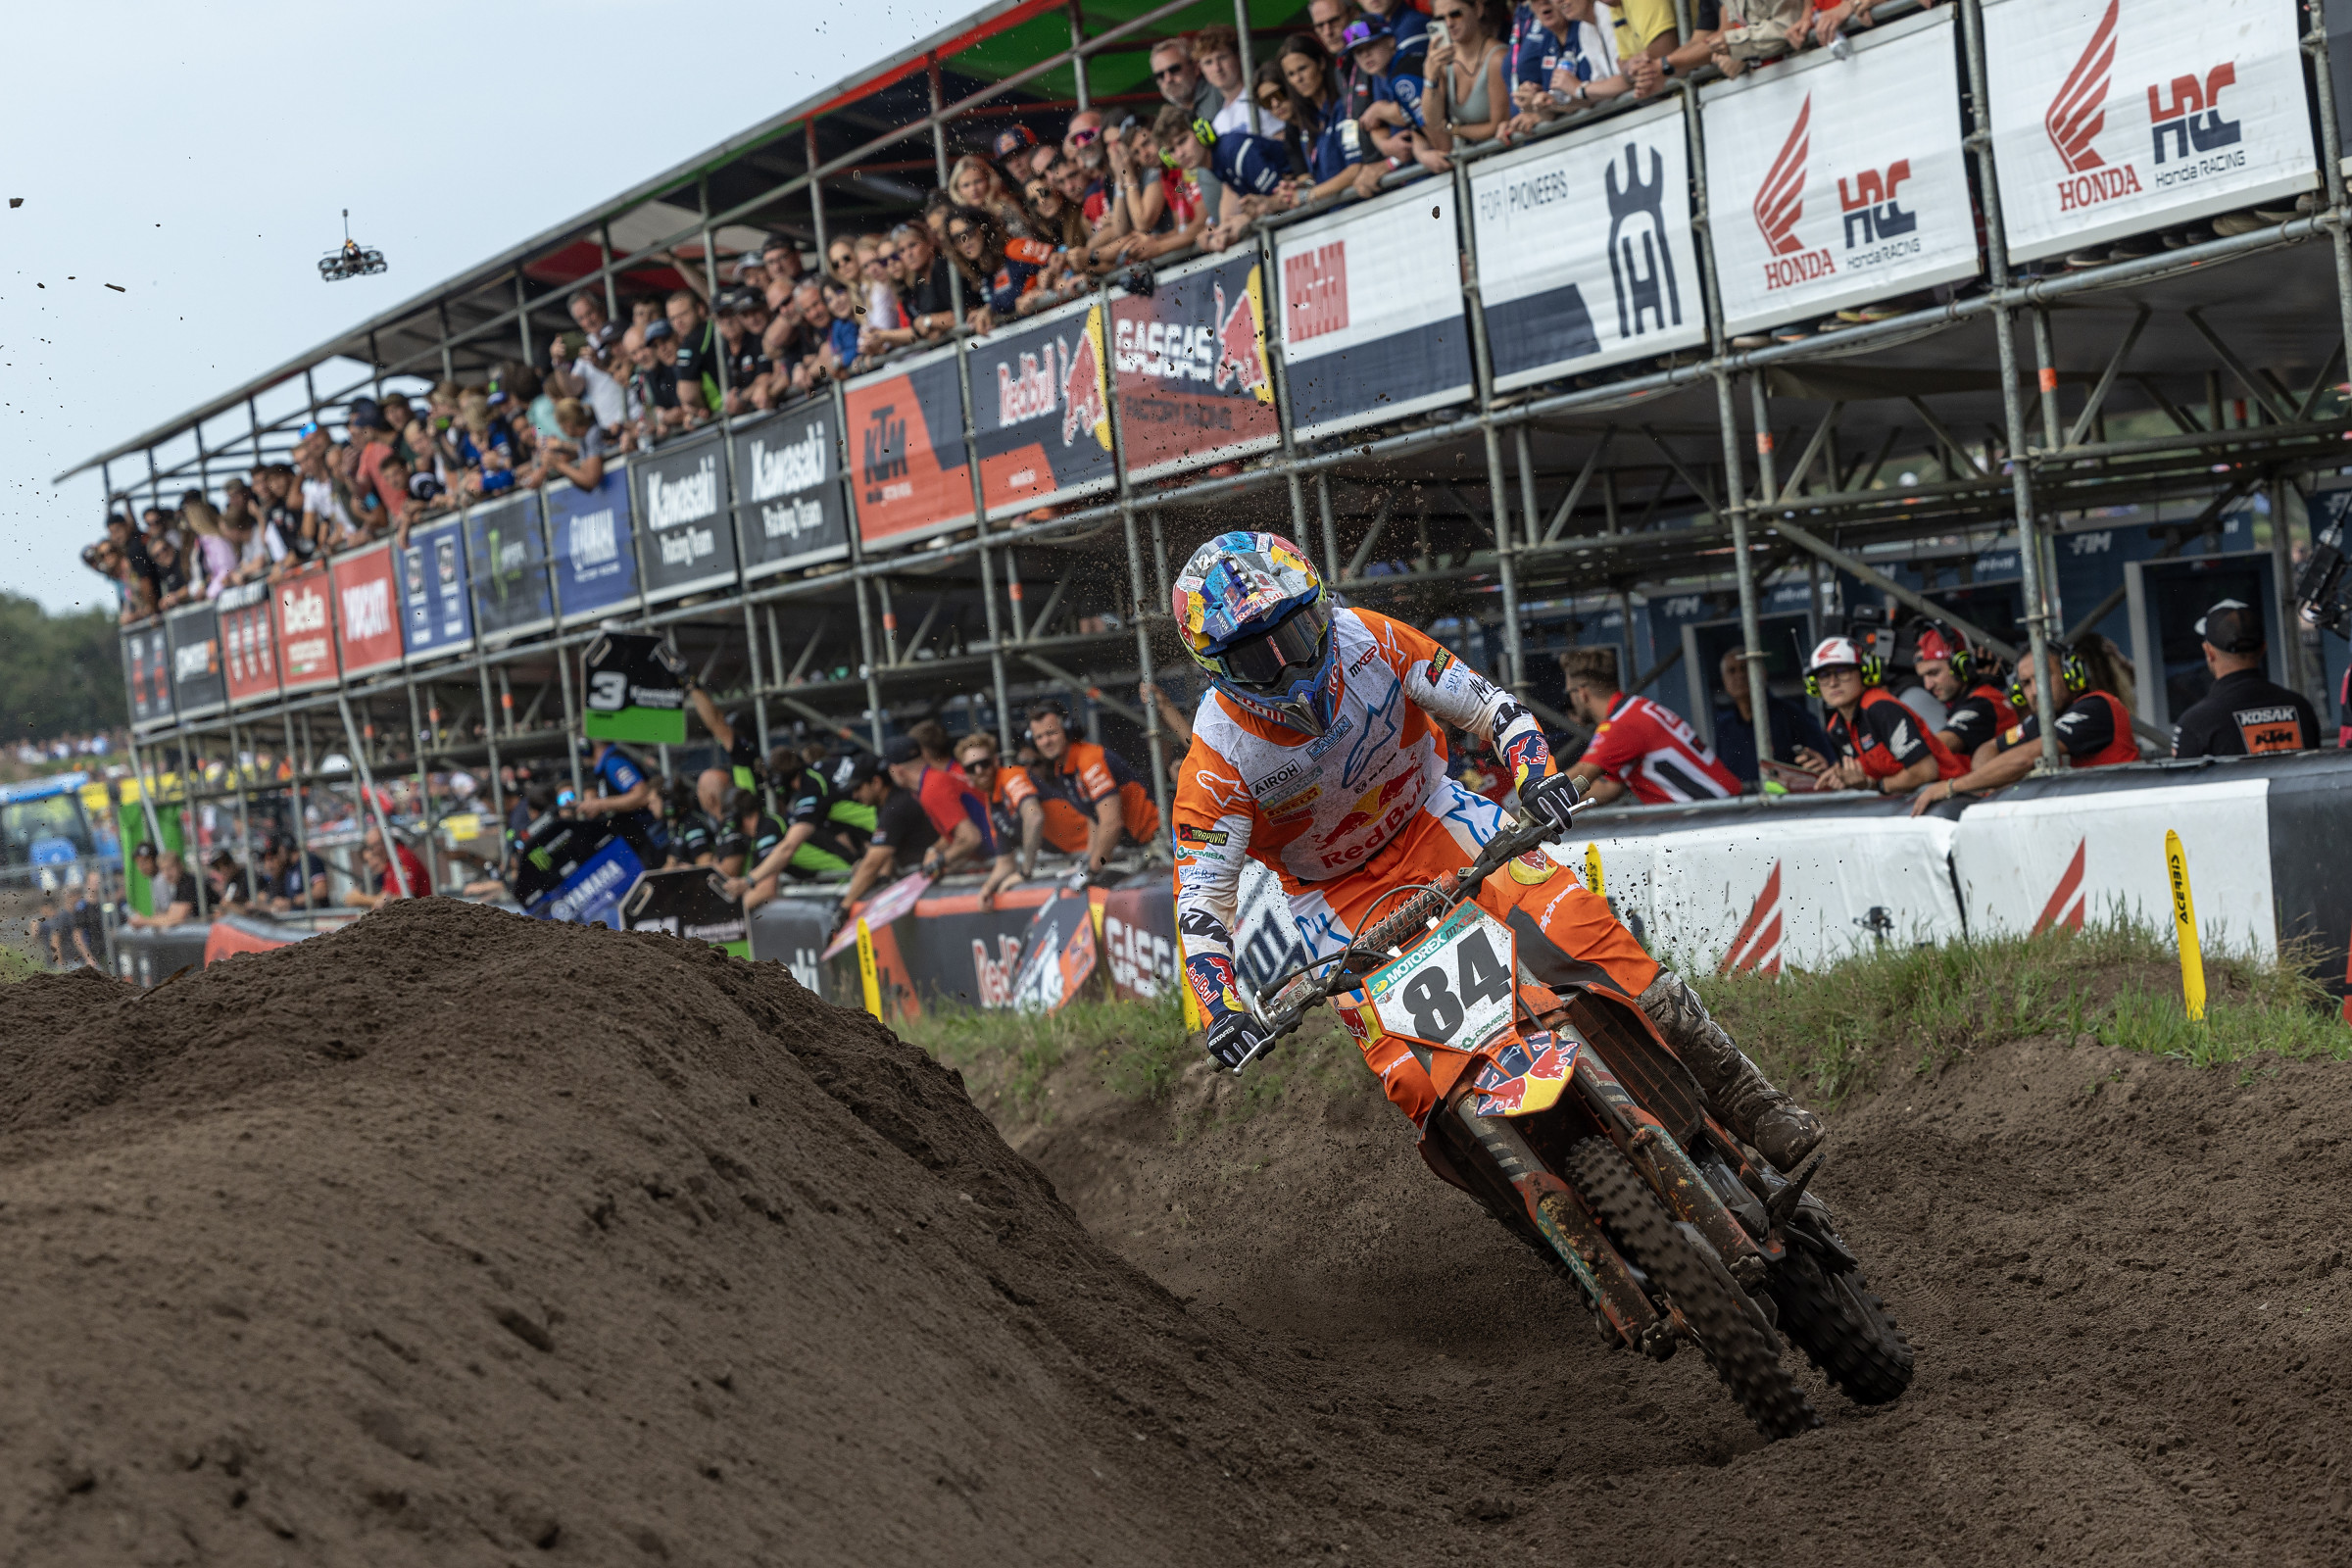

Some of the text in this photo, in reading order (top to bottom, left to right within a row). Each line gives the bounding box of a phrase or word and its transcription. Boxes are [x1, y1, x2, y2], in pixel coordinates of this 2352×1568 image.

[2058, 164, 2143, 212] HONDA
[2155, 149, 2246, 188] Honda RACING
[1508, 170, 1568, 212] PIONEERS
[1763, 247, 1836, 291] HONDA
[1114, 318, 1214, 383] GASGAS
[751, 420, 826, 503] Kawasaki
[864, 405, 907, 485] KTM
[648, 454, 717, 532] Kawasaki
[1348, 645, 1377, 678] MXGP
[589, 670, 627, 710] 3
[2240, 708, 2295, 726] KOSAK
[2256, 729, 2293, 746] KTM
[1254, 762, 1299, 796] AIROH
[1320, 773, 1427, 869] Red Bull
[1187, 849, 1226, 860] COMISA
[2171, 855, 2189, 925] ACERBIS
[1179, 907, 1234, 955] KTM
[1446, 908, 1479, 941] MXGP
[1387, 933, 1447, 985] MOTOREX
[1402, 926, 1512, 1046] 84
[1474, 1009, 1510, 1037] COMISA
